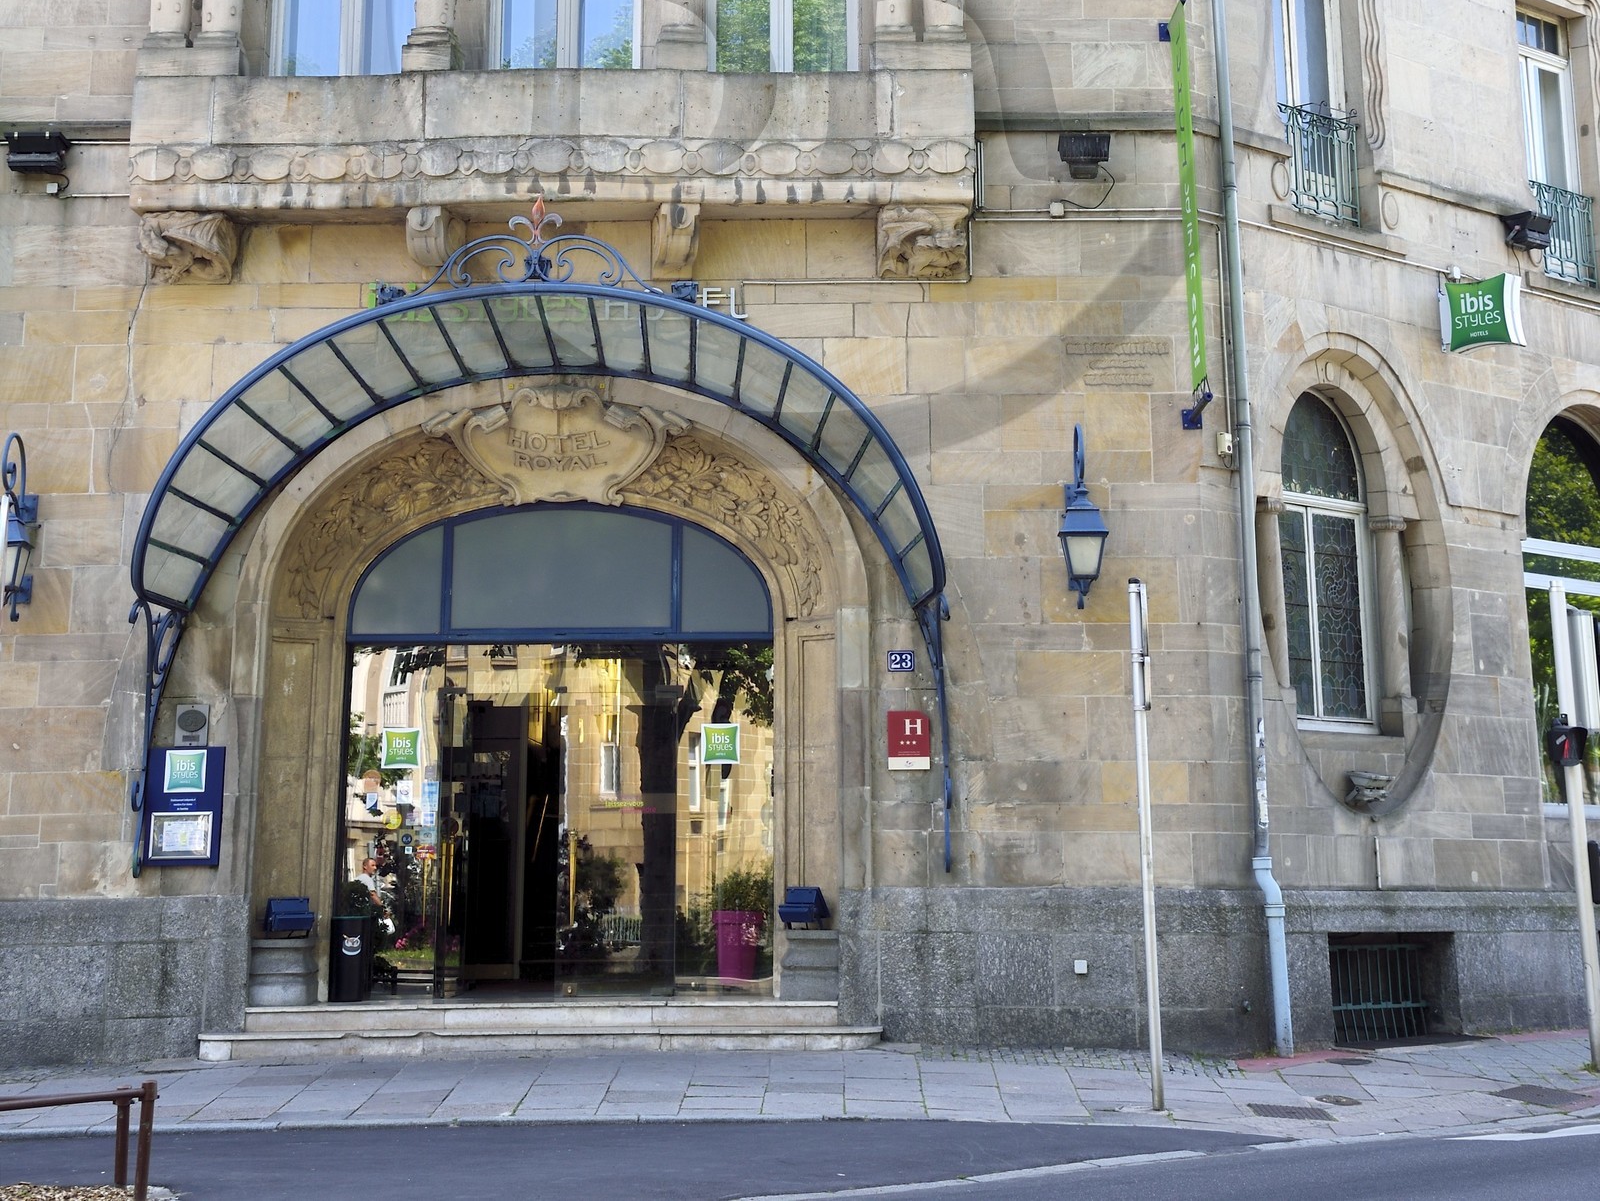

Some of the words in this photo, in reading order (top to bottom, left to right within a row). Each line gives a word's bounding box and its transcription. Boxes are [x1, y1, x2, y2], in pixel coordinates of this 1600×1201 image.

[1460, 290, 1494, 314] ibis
[1469, 329, 1489, 338] HOTELS
[507, 427, 611, 454] HOTEL
[513, 450, 608, 472] ROYAL
[890, 653, 912, 669] 23
[903, 718, 923, 736] H
[392, 737, 411, 748] ibis
[711, 733, 730, 744] ibis
[176, 759, 196, 771] ibis
